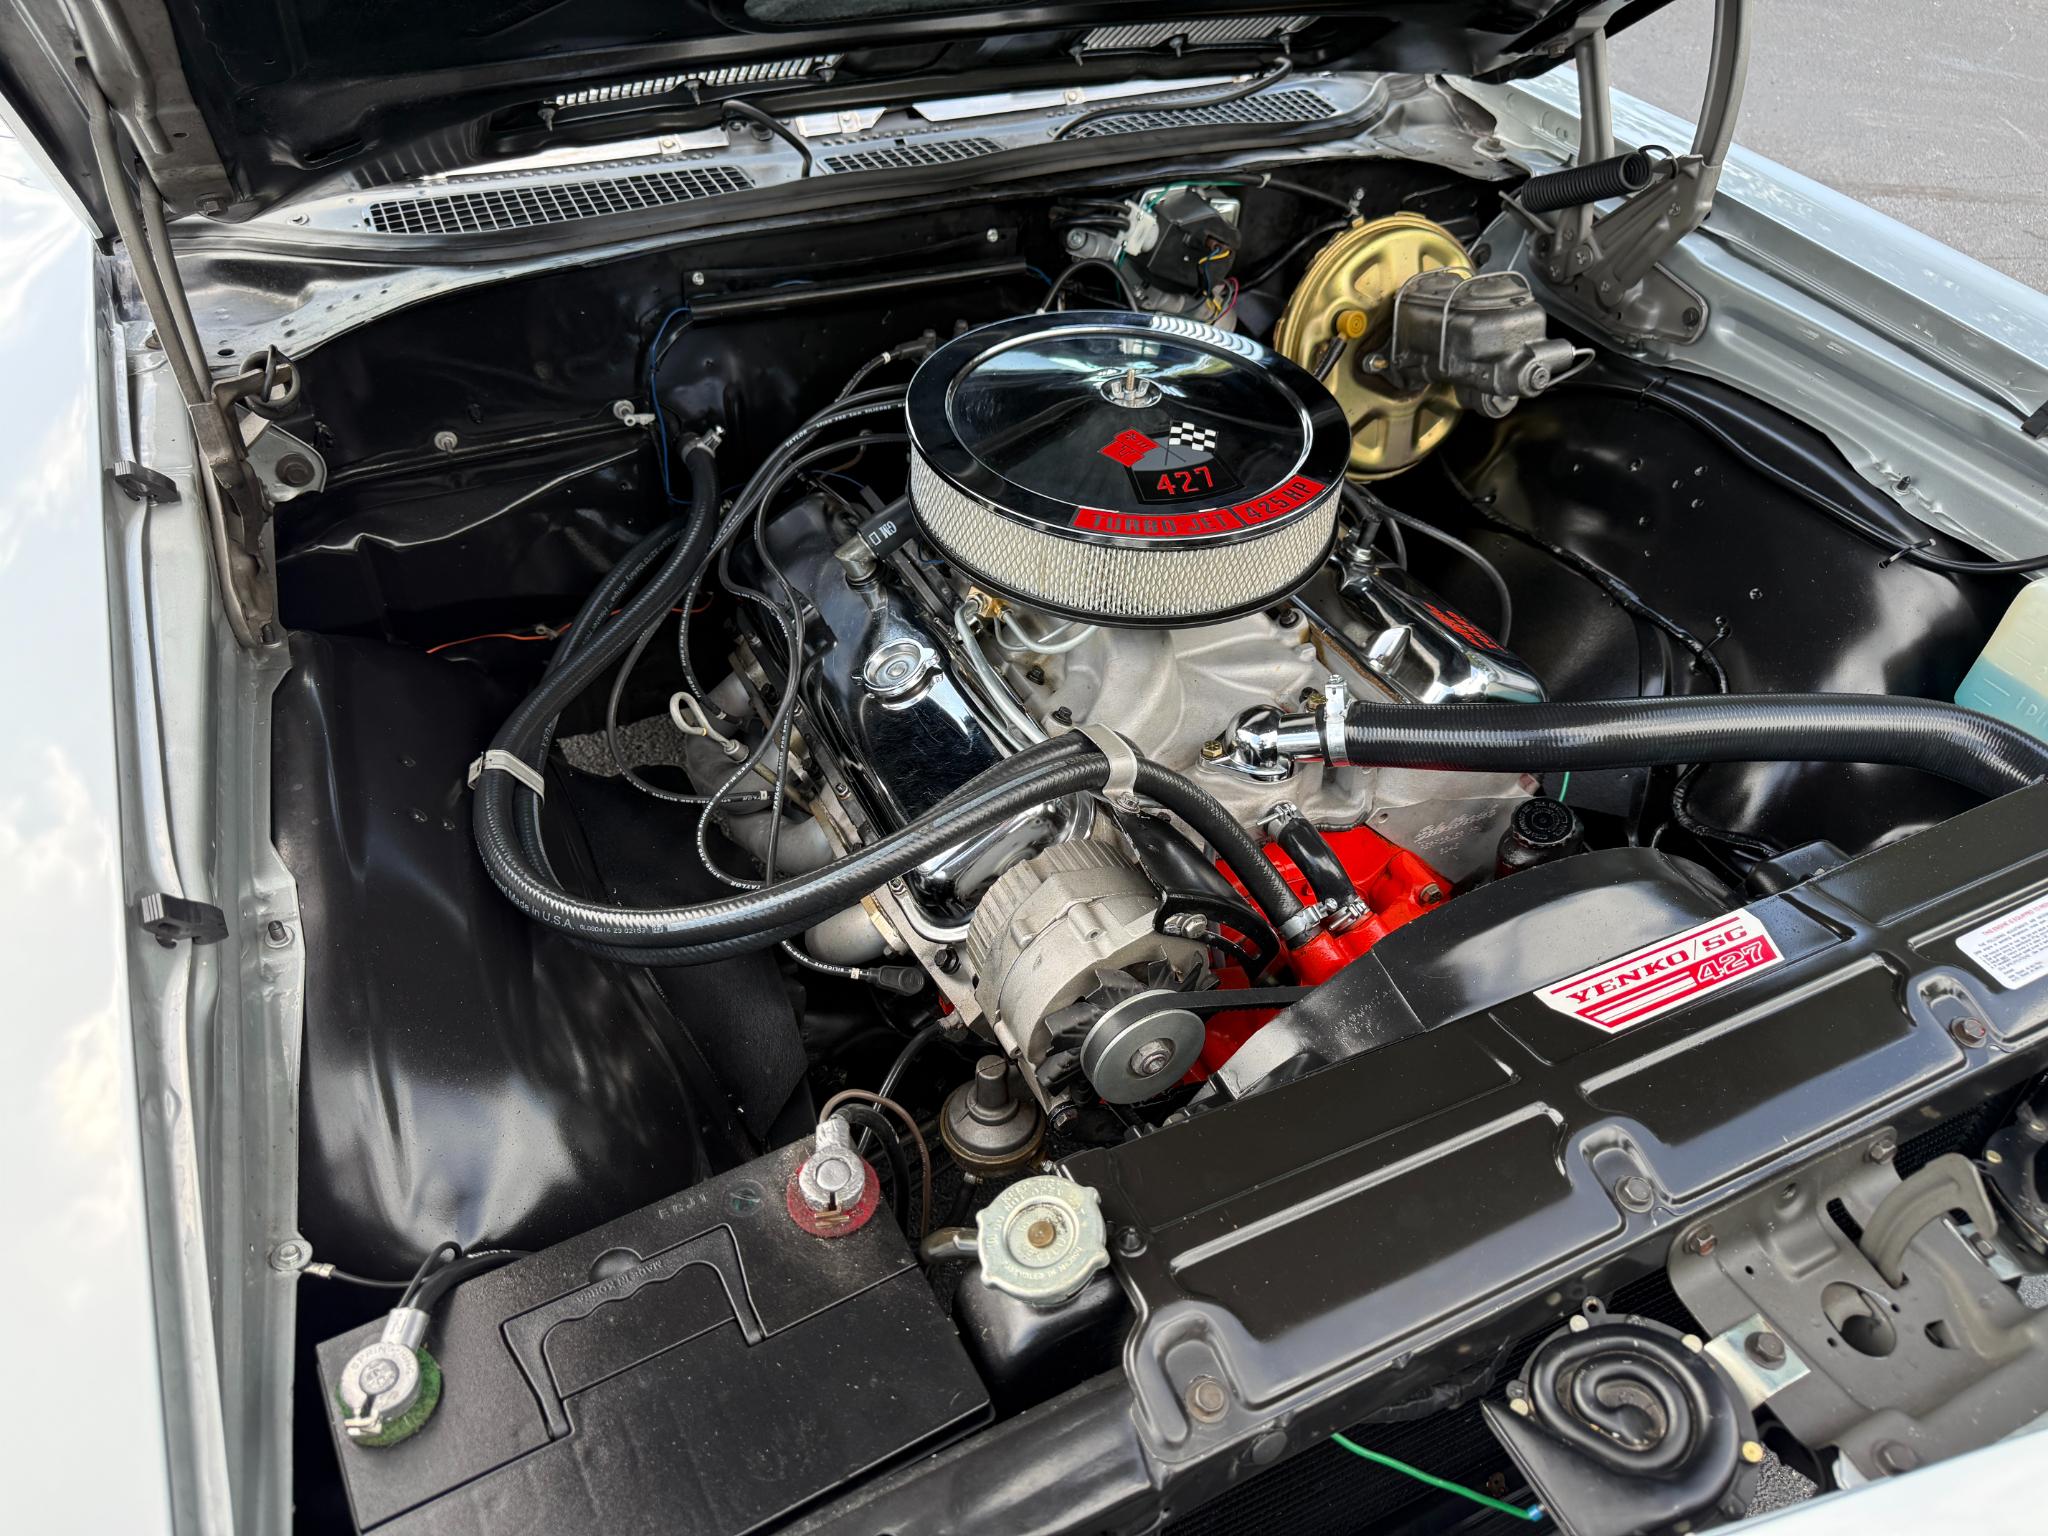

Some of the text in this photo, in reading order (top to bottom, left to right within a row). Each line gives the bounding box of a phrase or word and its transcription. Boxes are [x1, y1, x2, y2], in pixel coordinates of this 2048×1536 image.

[1156, 465, 1214, 495] 427
[1246, 495, 1290, 520] 425
[1292, 481, 1315, 501] HP
[773, 780, 781, 810] TAYLOR
[698, 848, 706, 862] PRO
[705, 862, 721, 879] SPIRO
[730, 880, 761, 890] TAYLOR
[509, 890, 530, 912] Made
[531, 905, 541, 917] in
[542, 909, 576, 931] U.S.A.
[1566, 925, 1748, 1004] YENKO/SC
[1696, 940, 1765, 984] 427
